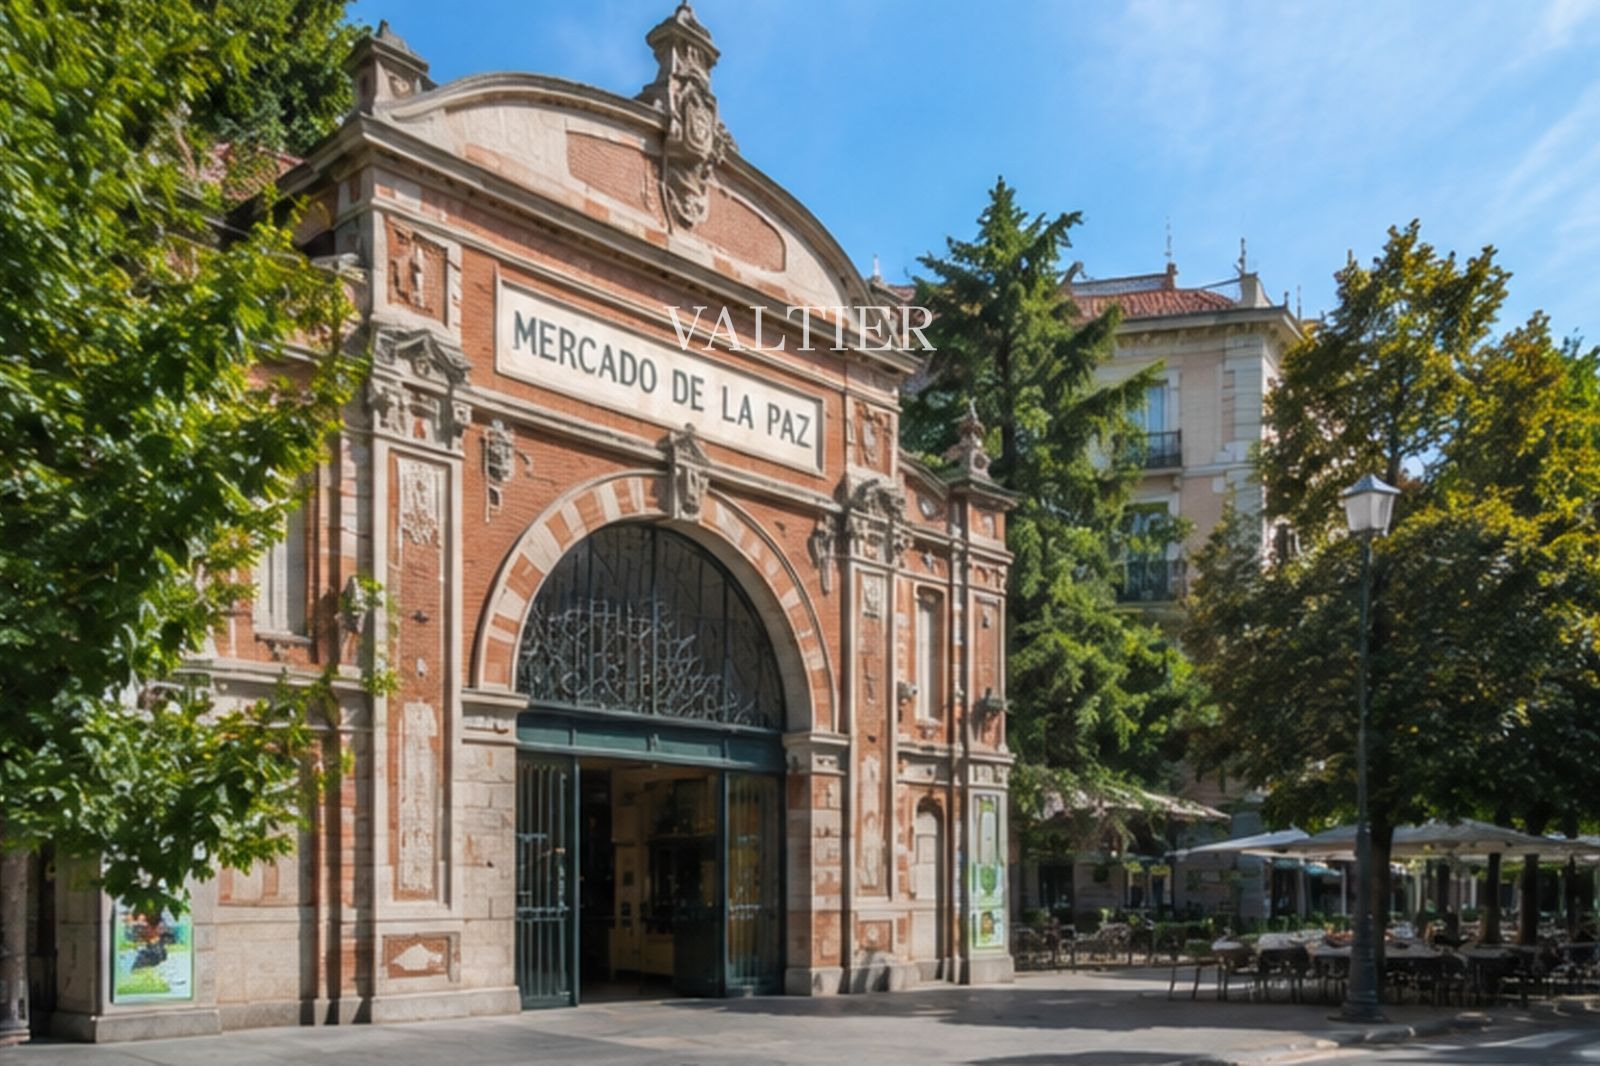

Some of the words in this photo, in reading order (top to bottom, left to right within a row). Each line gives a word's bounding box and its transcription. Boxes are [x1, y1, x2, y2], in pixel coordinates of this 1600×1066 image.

[513, 311, 657, 394] MERCADO
[672, 369, 705, 411] DE
[722, 385, 754, 430] LA
[767, 403, 812, 448] PAZ
